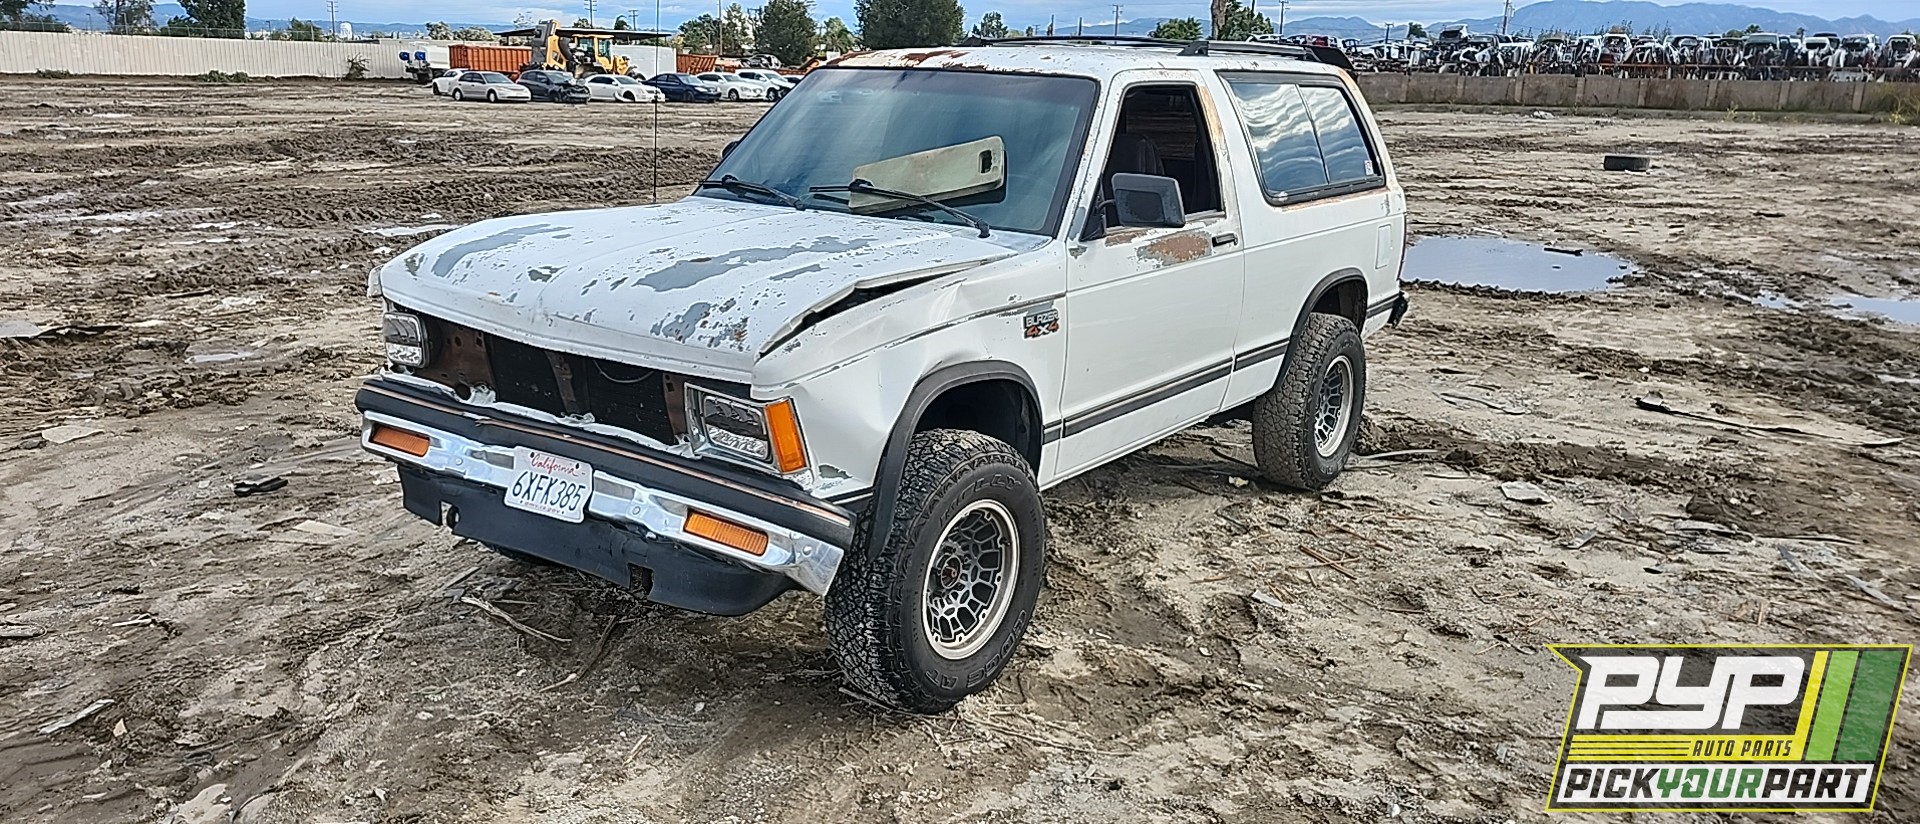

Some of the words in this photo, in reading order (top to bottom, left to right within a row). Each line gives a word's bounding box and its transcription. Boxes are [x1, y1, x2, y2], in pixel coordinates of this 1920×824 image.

[1026, 311, 1058, 327] BLAZER
[531, 453, 579, 477] California
[512, 471, 586, 511] 6XFK385
